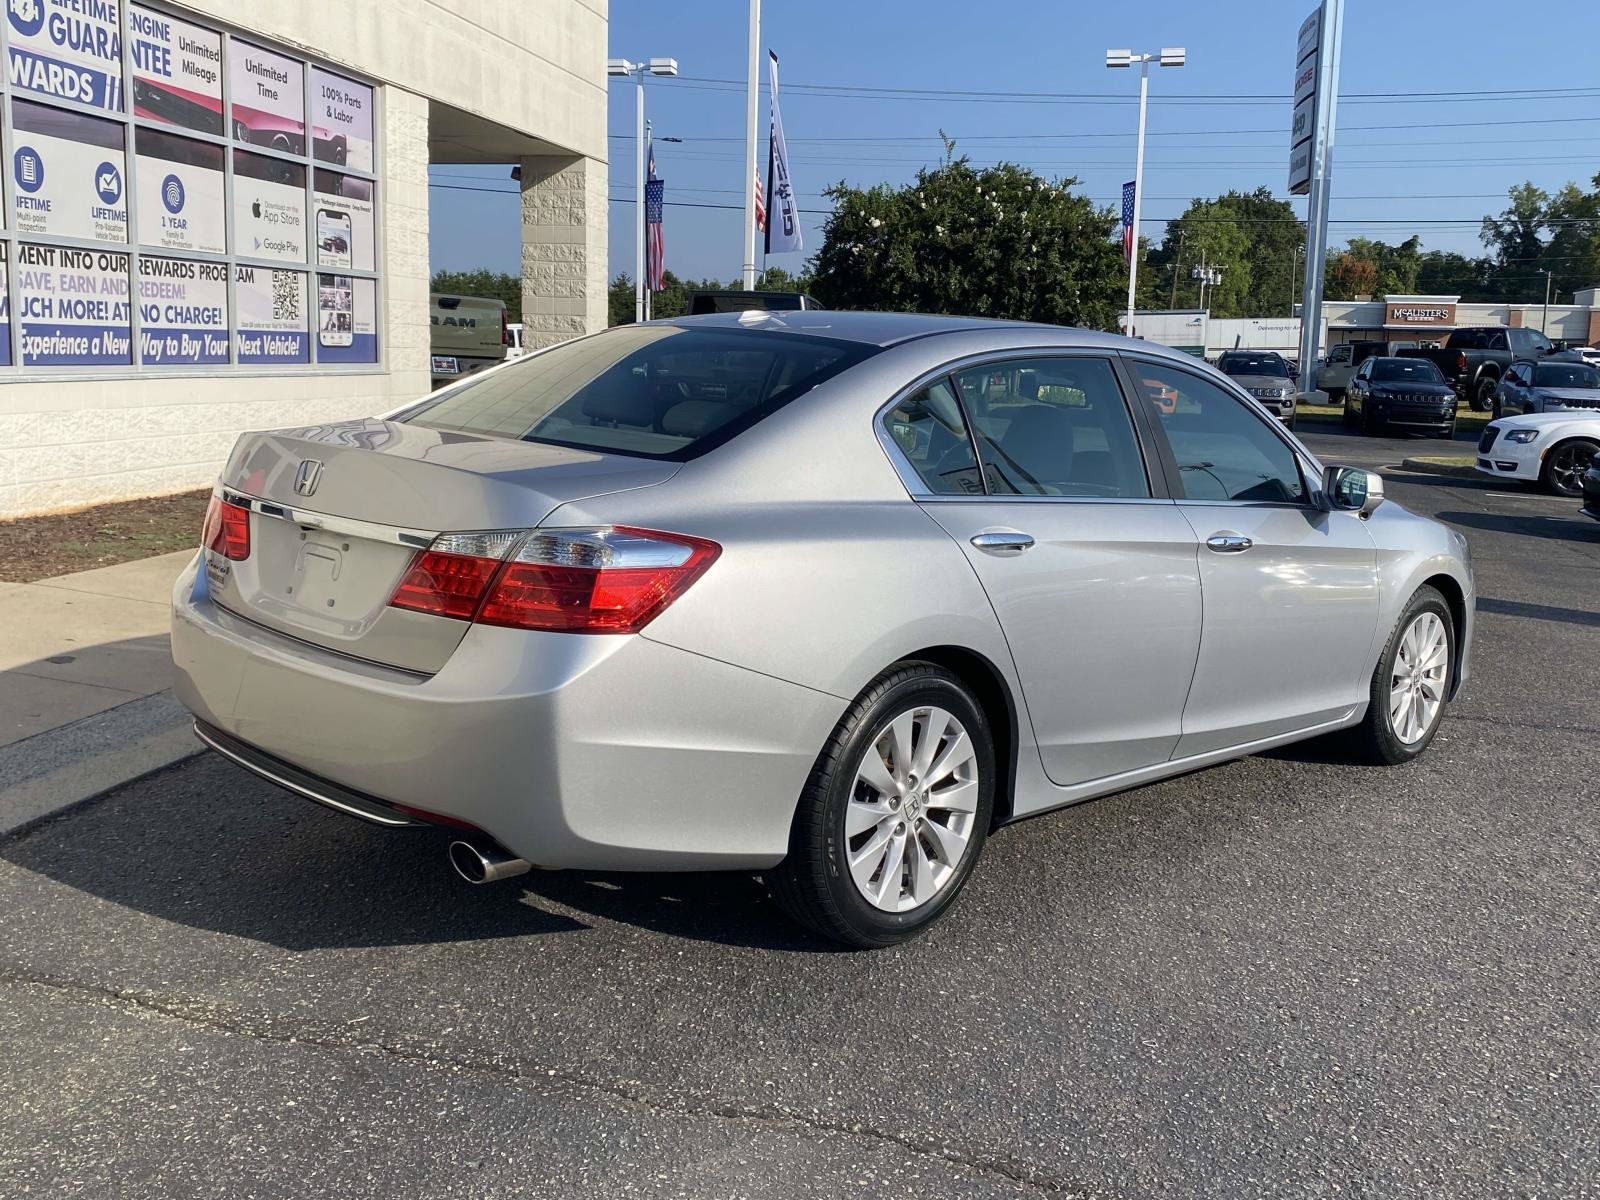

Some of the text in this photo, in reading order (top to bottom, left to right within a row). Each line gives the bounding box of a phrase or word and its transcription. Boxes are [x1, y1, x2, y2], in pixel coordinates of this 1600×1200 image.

[50, 0, 170, 43] FETIME NGINE
[179, 36, 220, 62] Unlimited
[182, 59, 216, 83] Mileage
[245, 58, 288, 84] Unlimited
[257, 82, 278, 101] Time
[322, 85, 362, 110] 100% Parts
[326, 105, 353, 124] & Labor
[16, 195, 52, 212] IFETIME
[91, 206, 126, 222] LIFETIME
[18, 222, 47, 233] Inspection
[161, 216, 187, 230] 1 YEAR
[263, 210, 300, 226] App Store
[263, 238, 299, 255] Google Play
[60, 250, 93, 270] INTO
[98, 254, 127, 272] OUR
[138, 258, 195, 279] REWARDS
[60, 274, 97, 294] EARN
[100, 277, 129, 295] AND
[138, 280, 186, 299] REDEEM!
[58, 299, 109, 320] MORE!
[112, 302, 129, 321] AT
[140, 304, 160, 323] NO
[165, 305, 222, 325] CHARGE!
[430, 316, 476, 328] RAM
[22, 329, 299, 361] Experience a New Way to Buy Your Next Vehicle!
